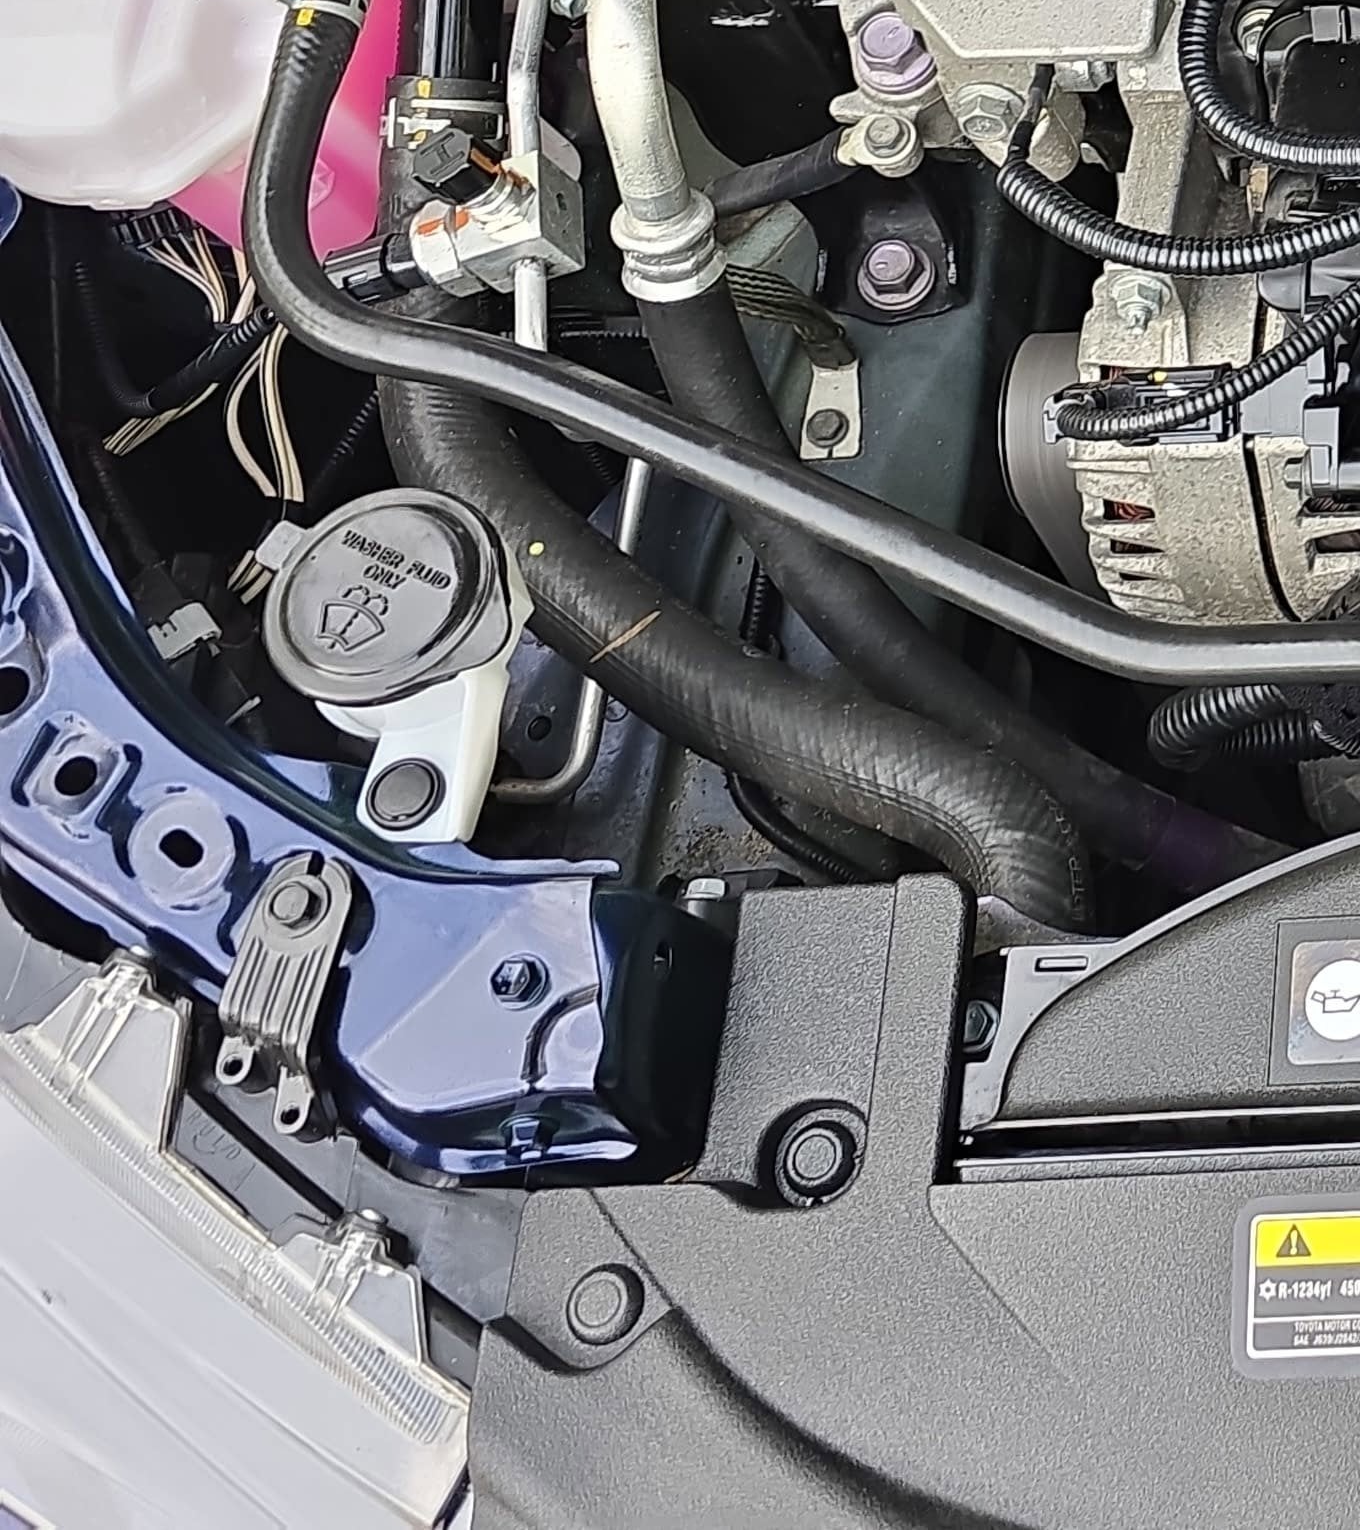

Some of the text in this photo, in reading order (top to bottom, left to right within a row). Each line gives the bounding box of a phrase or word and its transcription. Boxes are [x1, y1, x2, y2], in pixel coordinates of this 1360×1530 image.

[344, 529, 450, 591] WASHER FLUID
[362, 563, 408, 591] ONLY
[1294, 1320, 1322, 1333] TOYOTA
[1324, 1319, 1350, 1332] MOTOR
